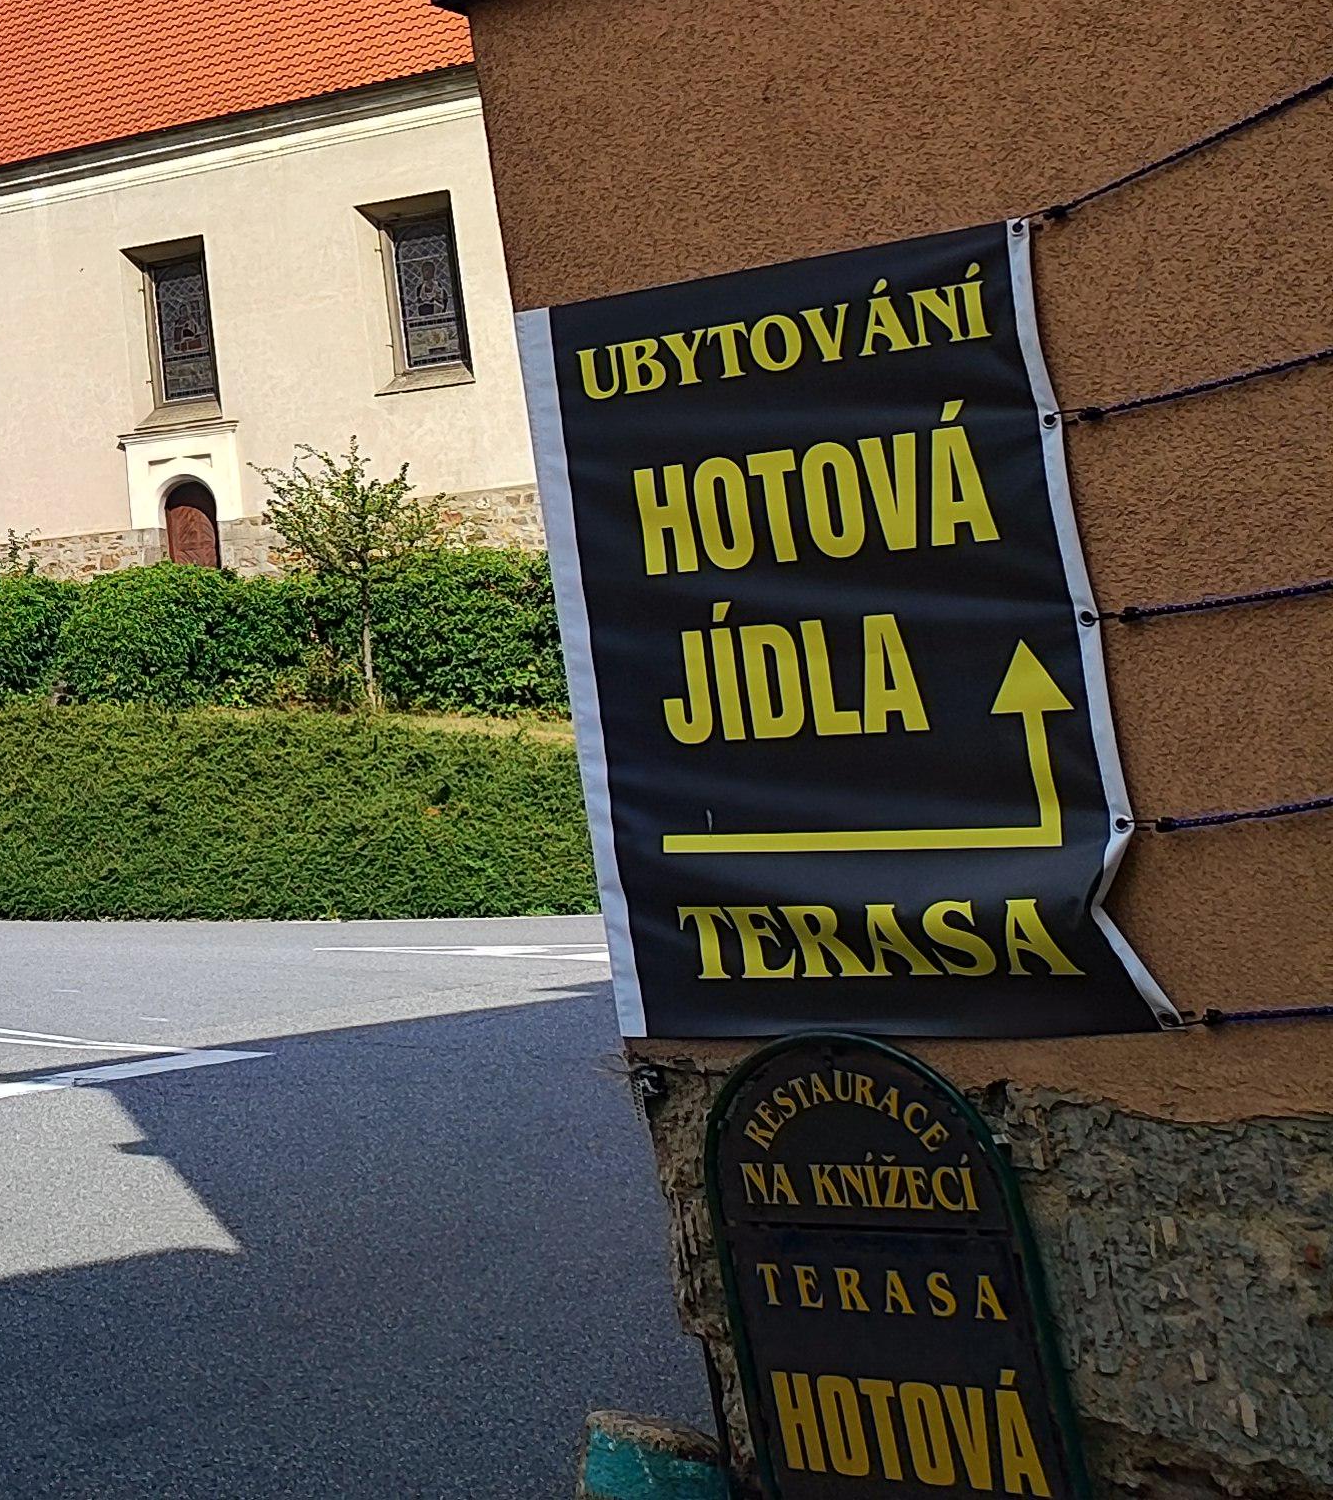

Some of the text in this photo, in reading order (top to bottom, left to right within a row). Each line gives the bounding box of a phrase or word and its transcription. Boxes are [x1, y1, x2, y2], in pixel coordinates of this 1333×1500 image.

[576, 262, 991, 400] UBYTOVÁNÍ
[633, 399, 1000, 576] HOTOVÁ
[664, 601, 930, 745] JÍDLA
[680, 899, 1086, 980] TERASA
[742, 1069, 950, 1152] RESTAURACE
[739, 1150, 980, 1212] NA KNÍŽECÍ
[756, 1262, 1009, 1321] TERASA
[770, 1369, 1054, 1499] HOTOVÁ
